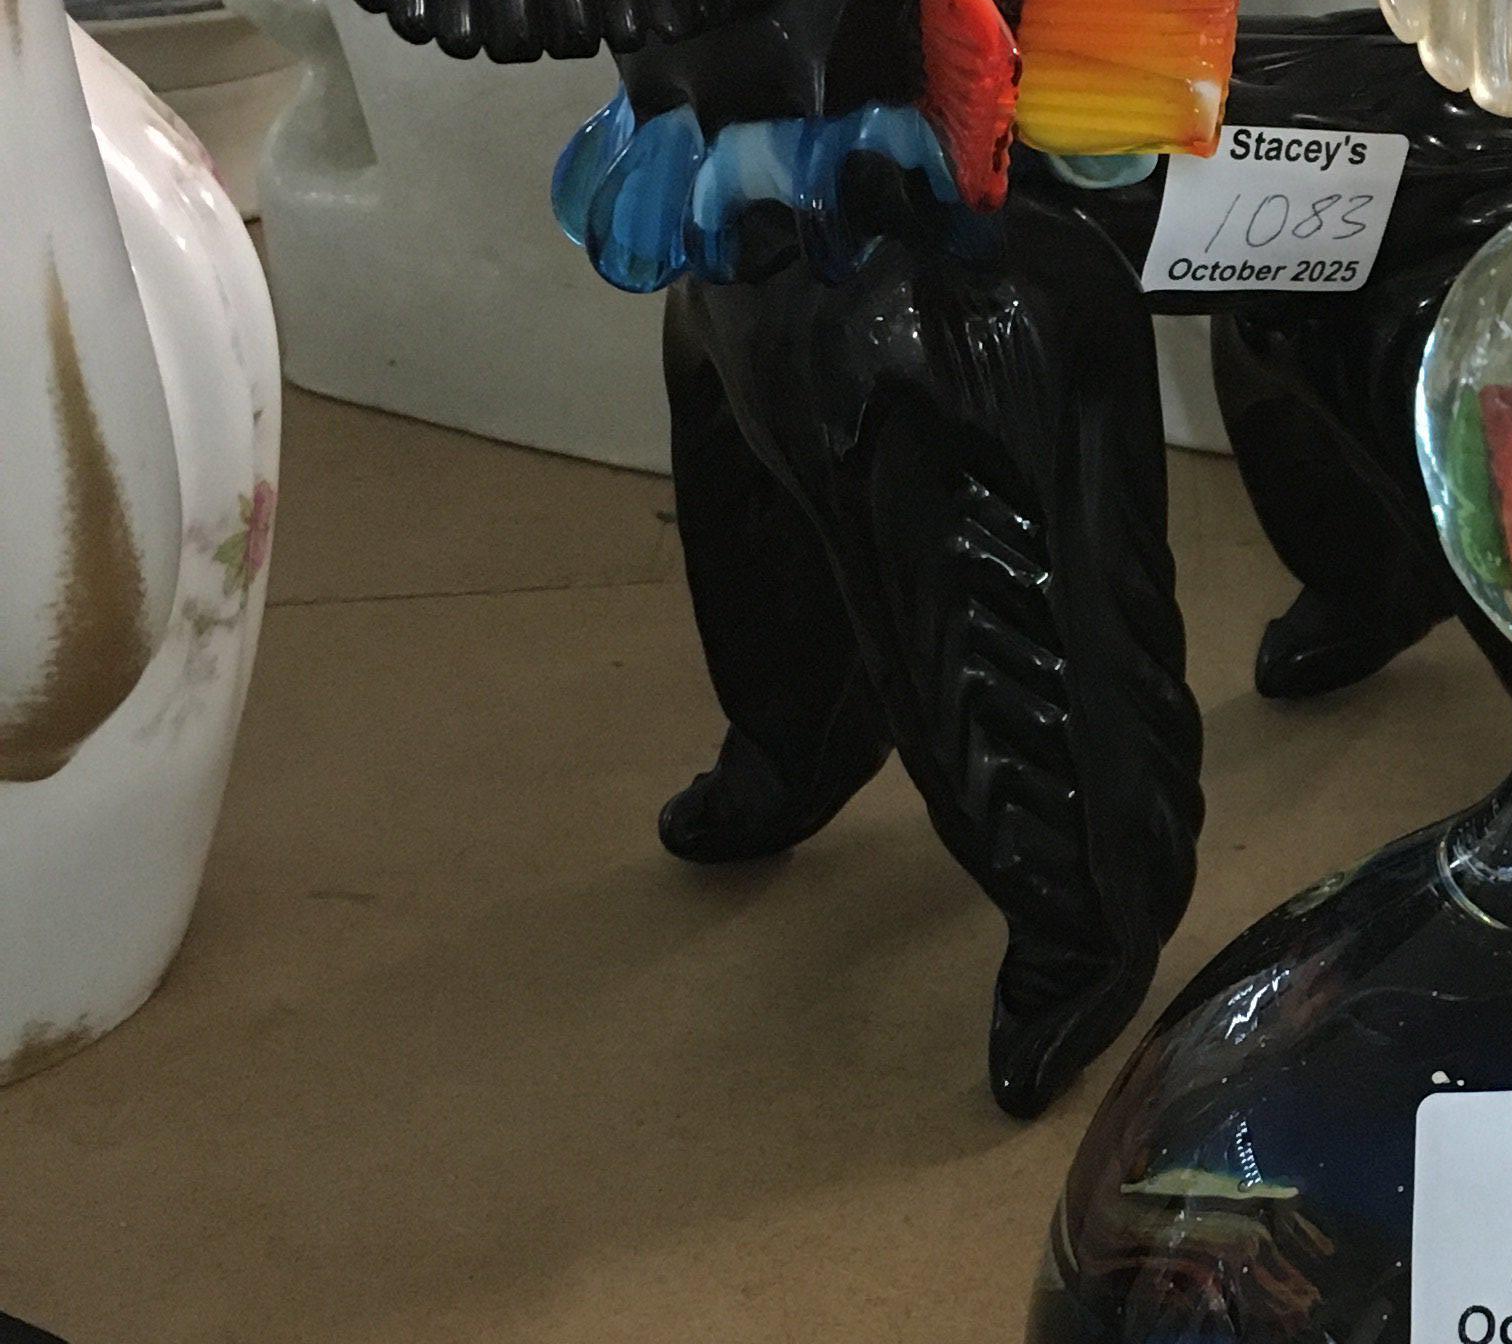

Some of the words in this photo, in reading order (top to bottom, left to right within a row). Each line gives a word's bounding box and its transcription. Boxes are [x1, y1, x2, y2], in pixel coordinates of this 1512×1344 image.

[1230, 128, 1367, 171] Stacey's
[1205, 194, 1374, 254] 1083
[1168, 258, 1286, 282] October
[1290, 260, 1360, 283] 2025
